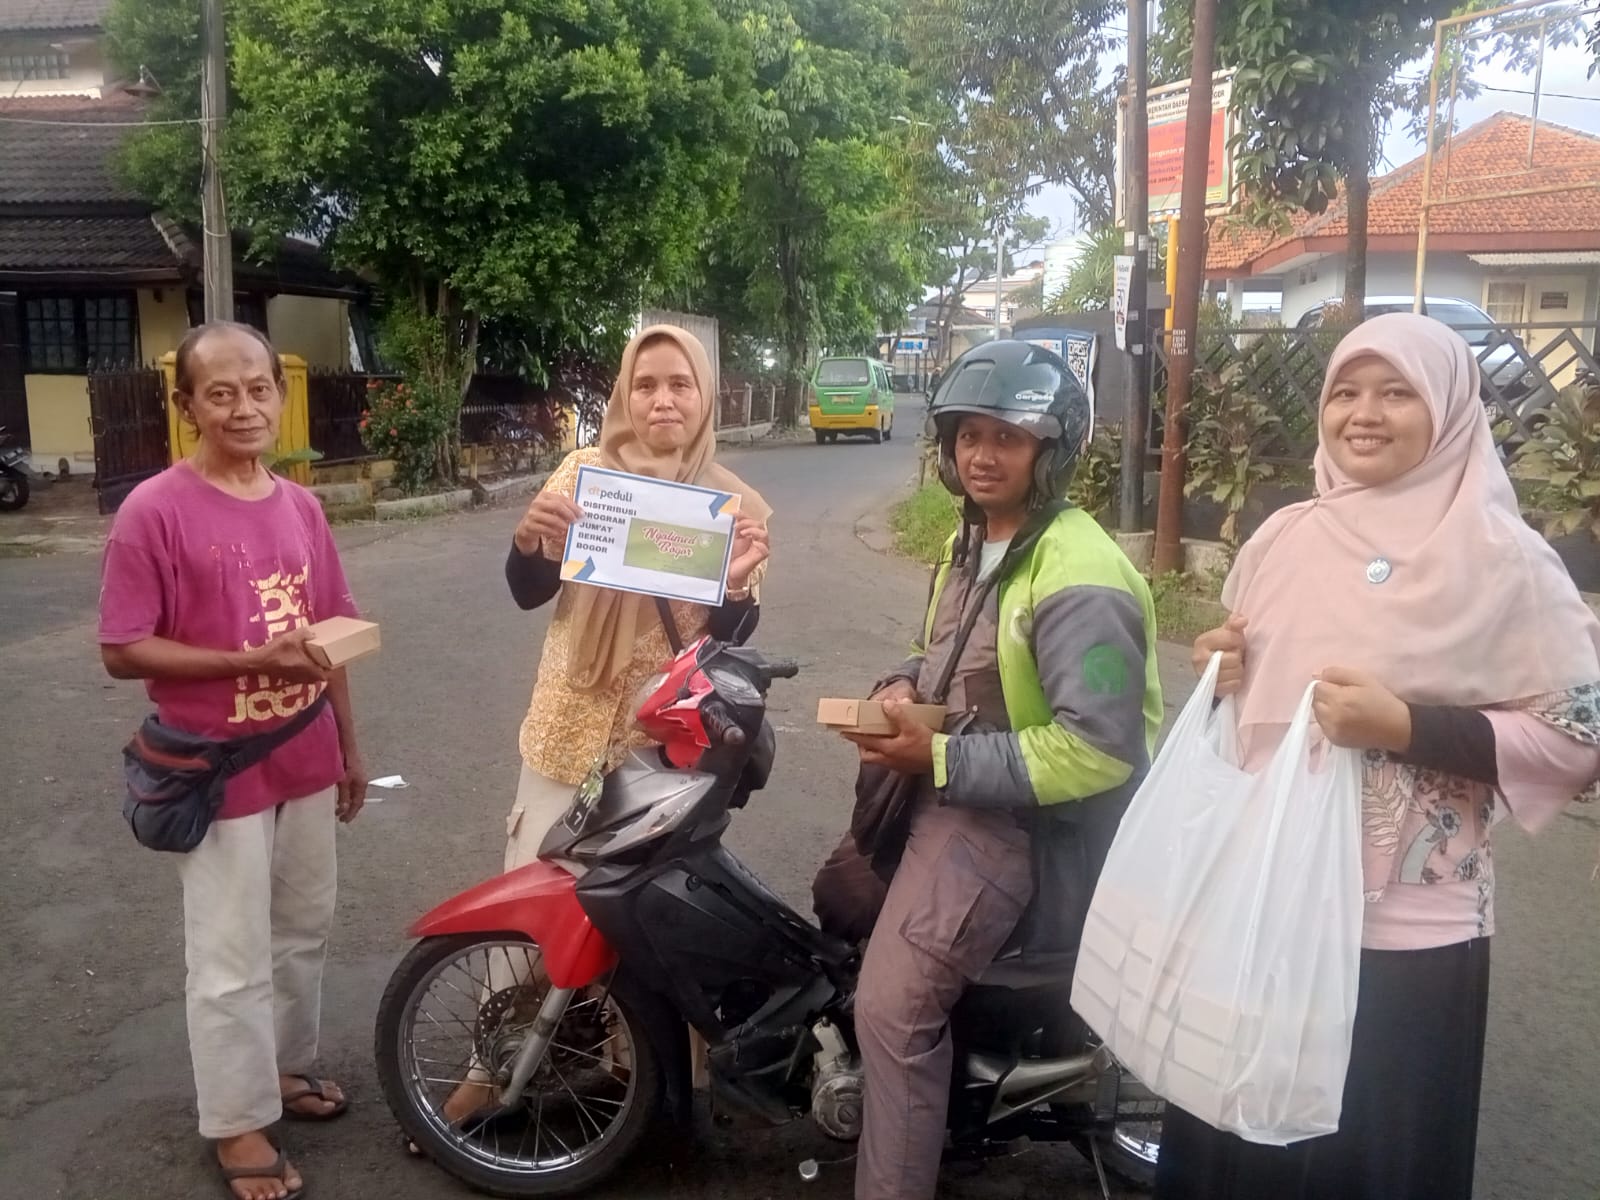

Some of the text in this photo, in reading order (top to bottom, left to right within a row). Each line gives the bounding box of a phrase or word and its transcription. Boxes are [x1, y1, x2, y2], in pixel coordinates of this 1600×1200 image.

[583, 501, 637, 516] DISITRIBUSI
[579, 521, 614, 533] JUM'AT
[578, 532, 615, 545] BERKAH
[576, 542, 608, 554] BOGOR
